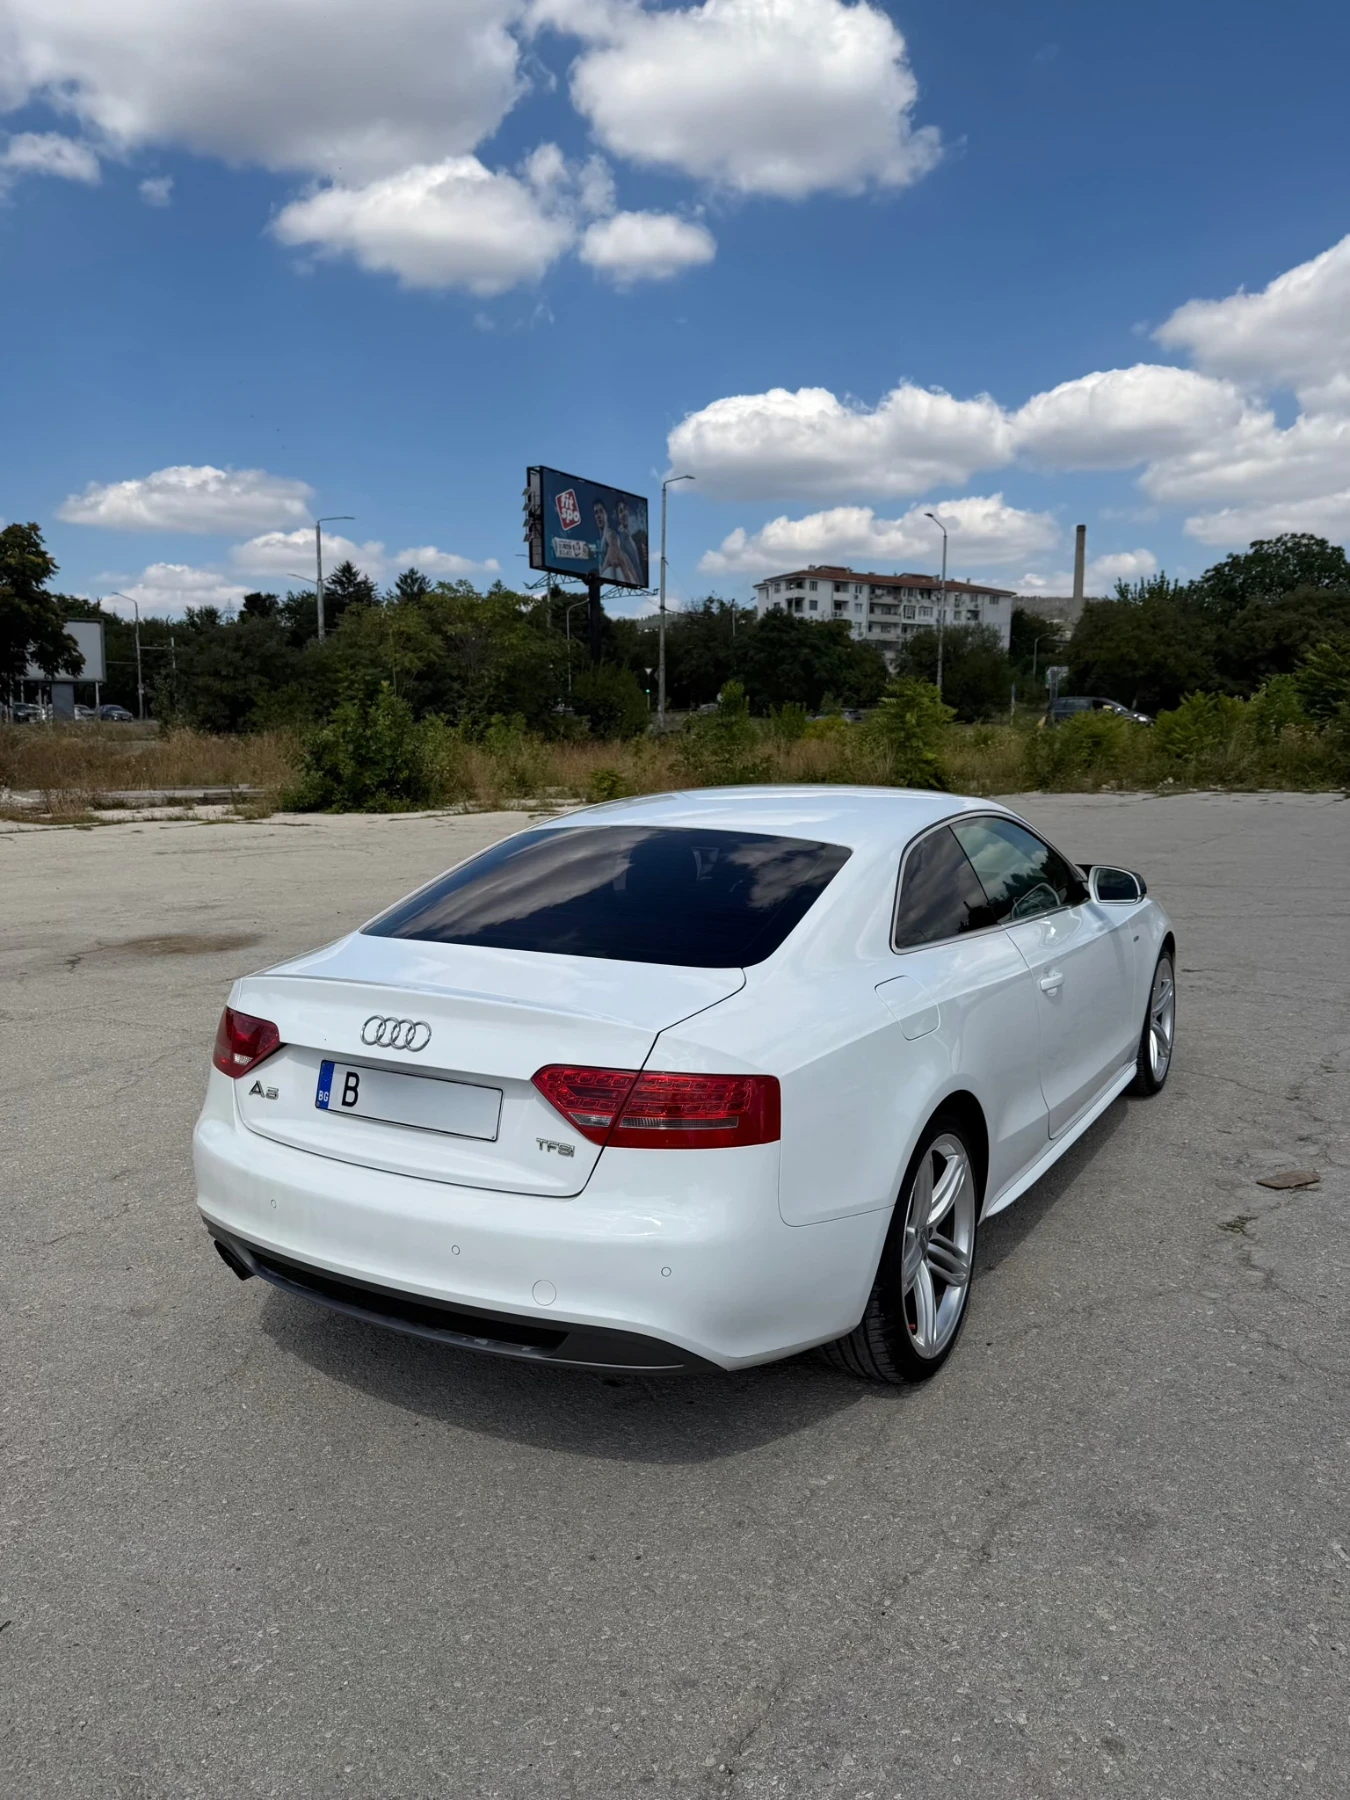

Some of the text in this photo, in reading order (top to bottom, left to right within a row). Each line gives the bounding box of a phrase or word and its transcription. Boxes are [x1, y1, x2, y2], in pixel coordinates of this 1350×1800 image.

[561, 493, 574, 510] fit
[561, 508, 580, 523] spo
[318, 1071, 360, 1108] BG B
[536, 1137, 575, 1158] TFSI
